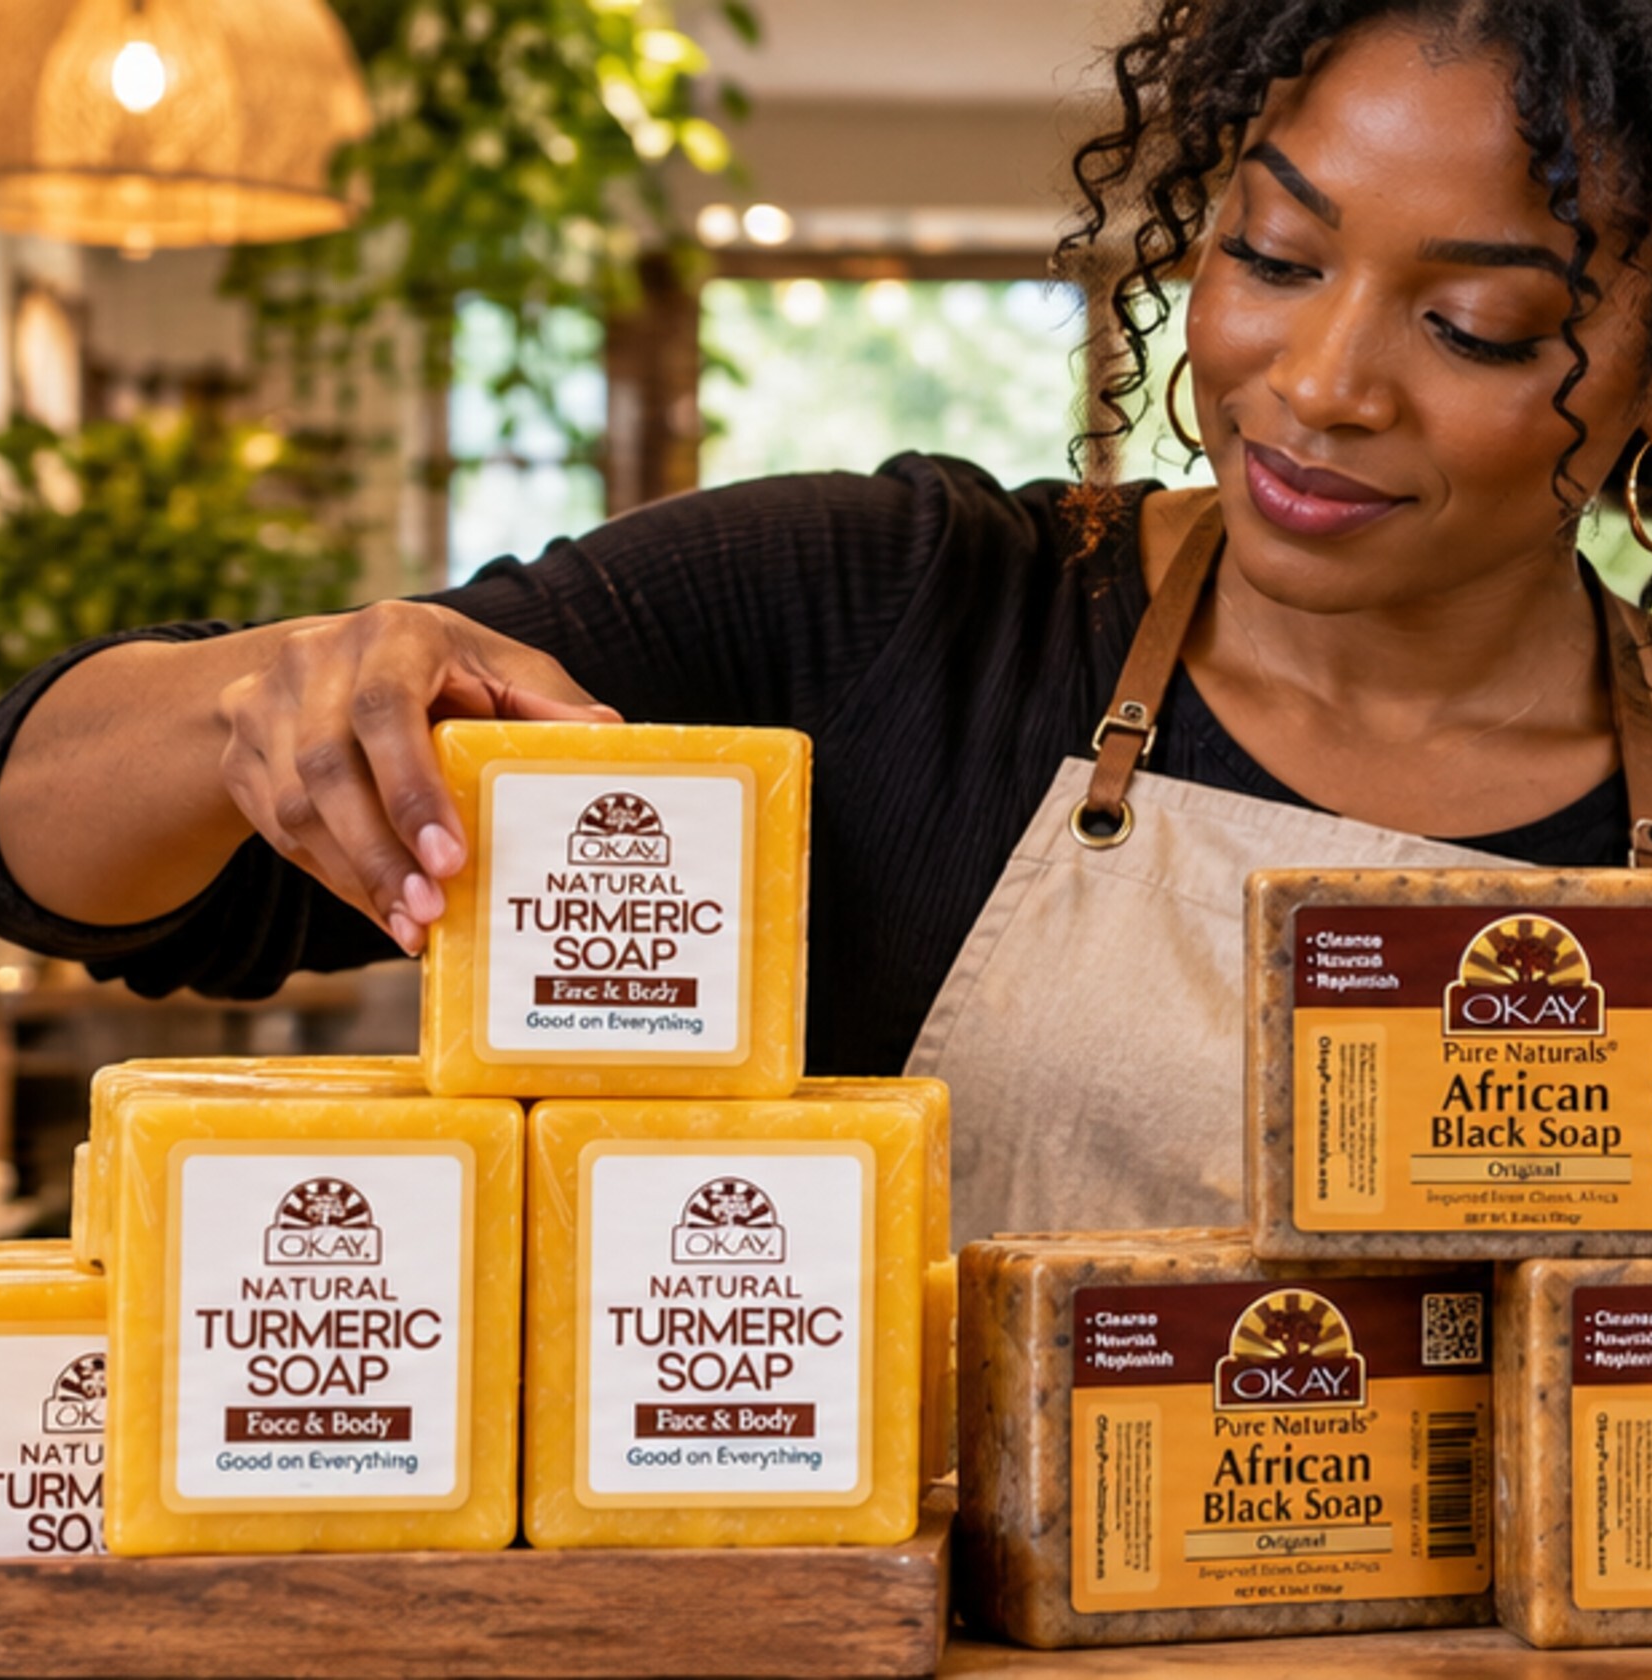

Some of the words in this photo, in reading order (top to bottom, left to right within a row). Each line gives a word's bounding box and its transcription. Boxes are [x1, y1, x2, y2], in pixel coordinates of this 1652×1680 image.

[548, 872, 684, 895] NATURAL
[508, 898, 723, 934] TURMERIC
[553, 937, 678, 971] SOAP
[628, 981, 679, 1004] Body
[526, 1012, 574, 1030] Good
[579, 1015, 603, 1030] on
[608, 1012, 704, 1035] Everything
[1443, 1041, 1498, 1063] Pure
[1441, 1071, 1610, 1112] African
[1431, 1116, 1527, 1149] Black
[1538, 1117, 1622, 1155] Soap
[1487, 1160, 1562, 1181] Original
[242, 1277, 398, 1301] NATURAL
[650, 1274, 803, 1299] NATURAL
[196, 1309, 442, 1349] TURMERIC
[608, 1306, 844, 1347] TURMERIC
[247, 1355, 389, 1397] SOAP
[657, 1351, 794, 1393] SOAP
[55, 1404, 103, 1427] OK
[304, 1412, 324, 1434] &
[331, 1410, 393, 1438] Body
[711, 1408, 732, 1431] &
[737, 1407, 797, 1435] Body
[1214, 1415, 1266, 1438] Pure
[20, 1443, 103, 1465] NATU
[216, 1452, 273, 1471] Good
[277, 1455, 304, 1471] on
[309, 1450, 419, 1475] Everything
[626, 1446, 682, 1467] Good
[686, 1450, 713, 1466] on
[716, 1445, 823, 1471] Everything
[1213, 1443, 1372, 1487] African
[1203, 1489, 1292, 1525] Black
[1304, 1488, 1384, 1525] Soap
[28, 1513, 105, 1552] SO
